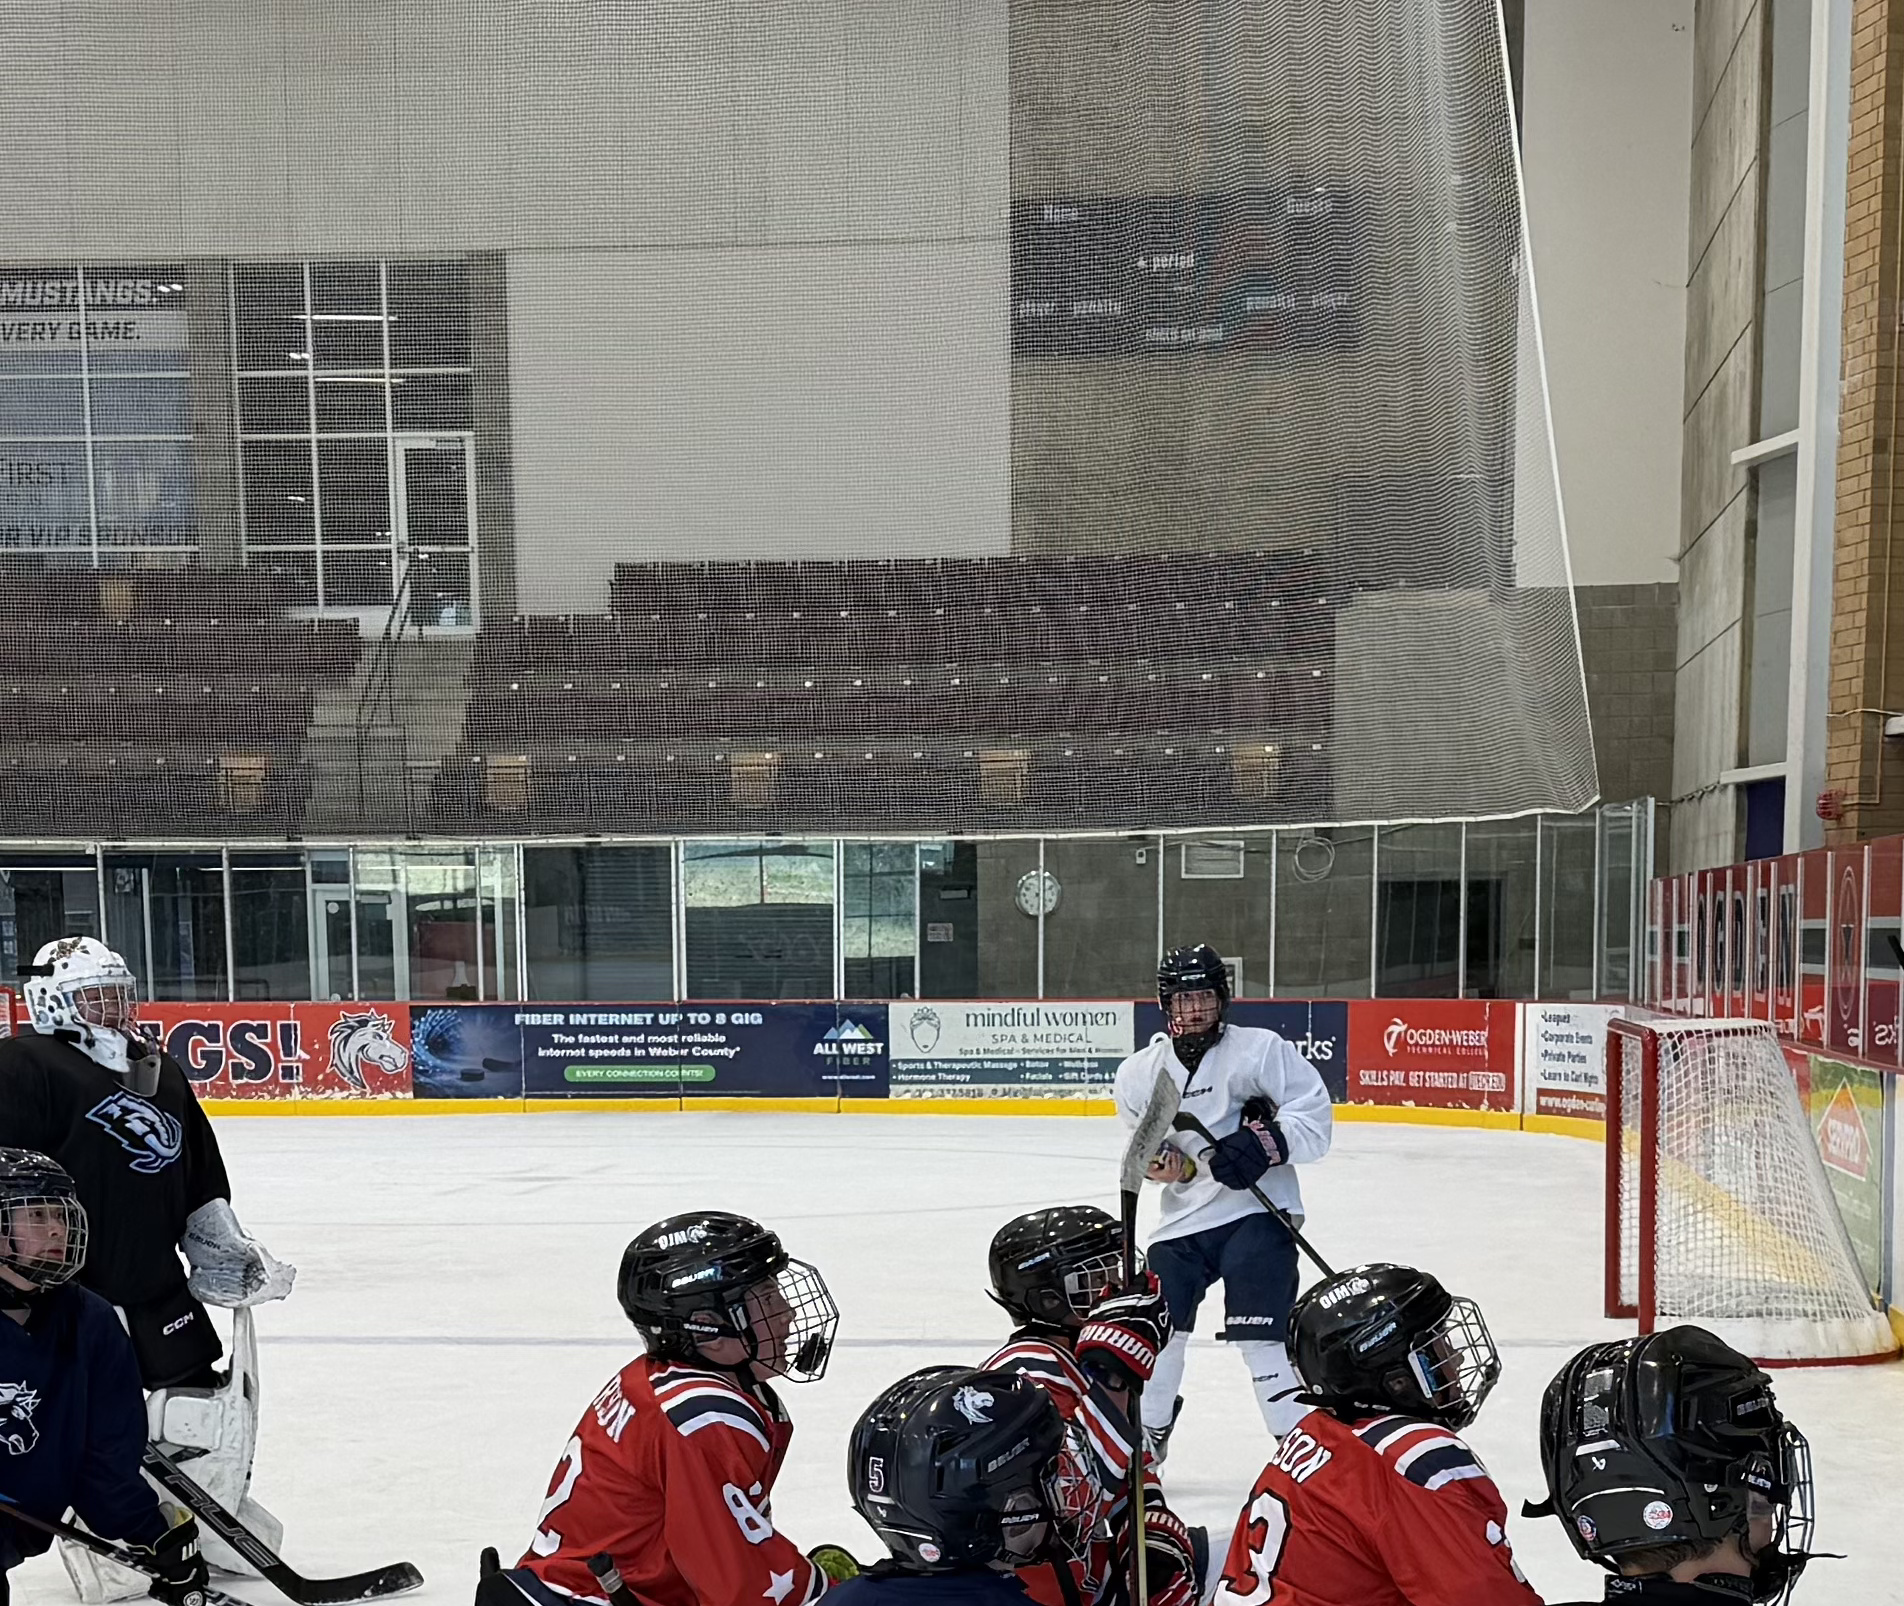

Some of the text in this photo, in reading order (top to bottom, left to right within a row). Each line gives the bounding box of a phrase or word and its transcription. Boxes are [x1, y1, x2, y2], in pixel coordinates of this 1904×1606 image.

[67, 318, 142, 343] GAME.
[514, 1012, 763, 1026] FIBER INTERNET UP TO 8 GIG
[966, 1007, 1117, 1028] mindful women
[552, 1033, 726, 1044] The fastest and most reliable
[991, 1032, 1093, 1045] SPA & MEDICAL
[1406, 1029, 1488, 1047] OGDEN-WEBER
[1543, 1029, 1575, 1045] Corporate
[588, 1047, 632, 1060] speeds
[634, 1047, 646, 1058] in
[813, 1042, 884, 1055] ALL WEST
[959, 1048, 975, 1057] Spa
[983, 1047, 1015, 1056] Medical
[1021, 1047, 1054, 1056] Services
[1407, 1046, 1452, 1055] TECHNICAL
[827, 1057, 872, 1066] FIBER
[1543, 1049, 1587, 1064] Private Parties
[898, 1061, 925, 1071] Sports
[933, 1061, 983, 1071] Therapeutic
[984, 1061, 1018, 1071] Massage
[576, 1069, 604, 1078] EVERY
[606, 1069, 664, 1078] CONNECTION
[898, 1073, 937, 1082] Hormone
[938, 1073, 971, 1083] Therapy
[1359, 1069, 1388, 1086] SKILLS
[1409, 1070, 1424, 1087] GET
[1424, 1071, 1458, 1088] STARTED
[1543, 1069, 1562, 1081] Learn
[671, 1268, 716, 1288] BAUER
[163, 1311, 195, 1336] CCM
[1225, 1315, 1274, 1326] BAUER
[988, 1436, 1031, 1474] BAUER
[868, 1455, 885, 1493] 5
